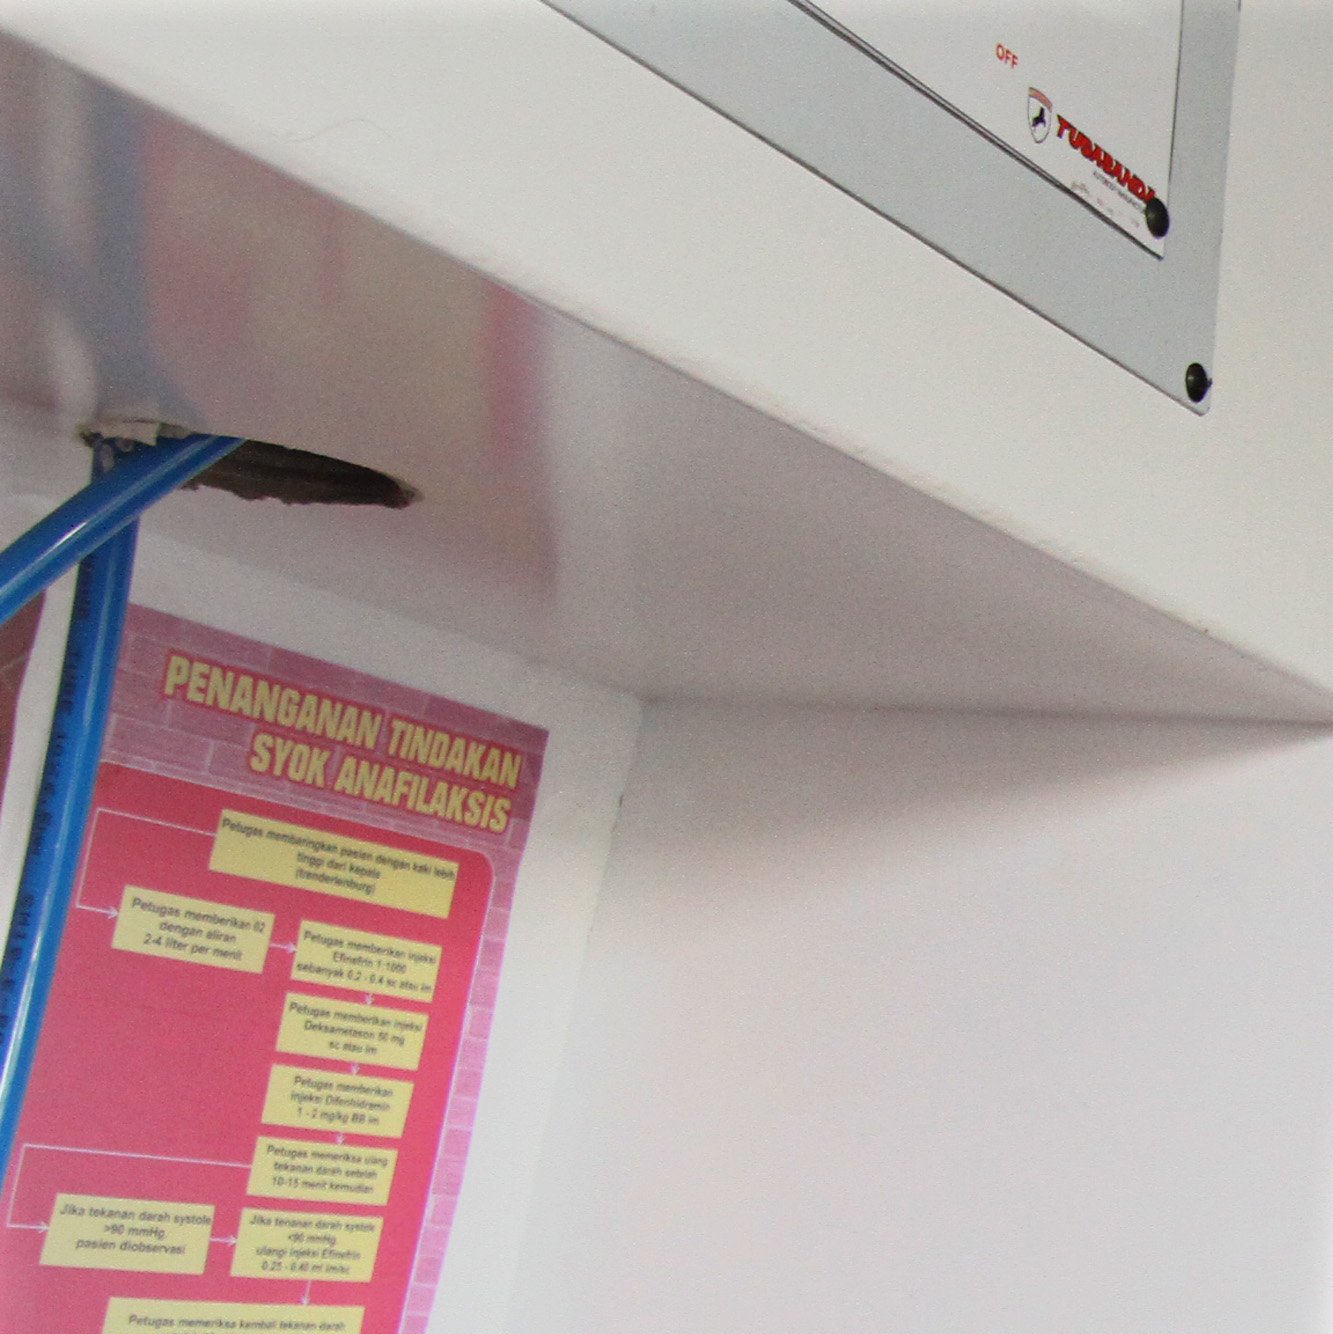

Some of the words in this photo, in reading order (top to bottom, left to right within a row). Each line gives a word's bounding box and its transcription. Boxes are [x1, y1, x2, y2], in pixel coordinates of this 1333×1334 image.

[996, 43, 1019, 69] OFF
[165, 655, 382, 750] PENANGANAN
[388, 719, 523, 789] TINDAKAN
[250, 733, 333, 789] SYOK
[334, 755, 512, 833] ANAFILAKSIS
[222, 817, 264, 838] Petugas
[375, 854, 411, 872] dengan
[132, 897, 181, 918] Petugas
[184, 909, 250, 930] memberikan
[160, 921, 203, 938] dengan
[206, 927, 237, 943] aliran
[303, 930, 343, 948] Petugas
[347, 941, 406, 958] memberikan
[143, 933, 162, 946] 2-4
[165, 936, 188, 950] liter
[190, 943, 209, 957] per
[212, 947, 243, 961] menit
[296, 962, 344, 979] sebanyak
[289, 1002, 331, 1018] Petugas
[333, 1010, 391, 1027] memberikan
[294, 1075, 334, 1091] Petugas
[336, 1081, 393, 1097] memberikan
[266, 1144, 308, 1160] Petugas
[60, 1204, 85, 1216] Jika
[89, 1207, 135, 1220] tekanan
[138, 1210, 170, 1223] darah
[75, 1238, 116, 1251] pasien
[119, 1239, 186, 1254] diobservasi
[129, 1314, 175, 1330] Petugas
